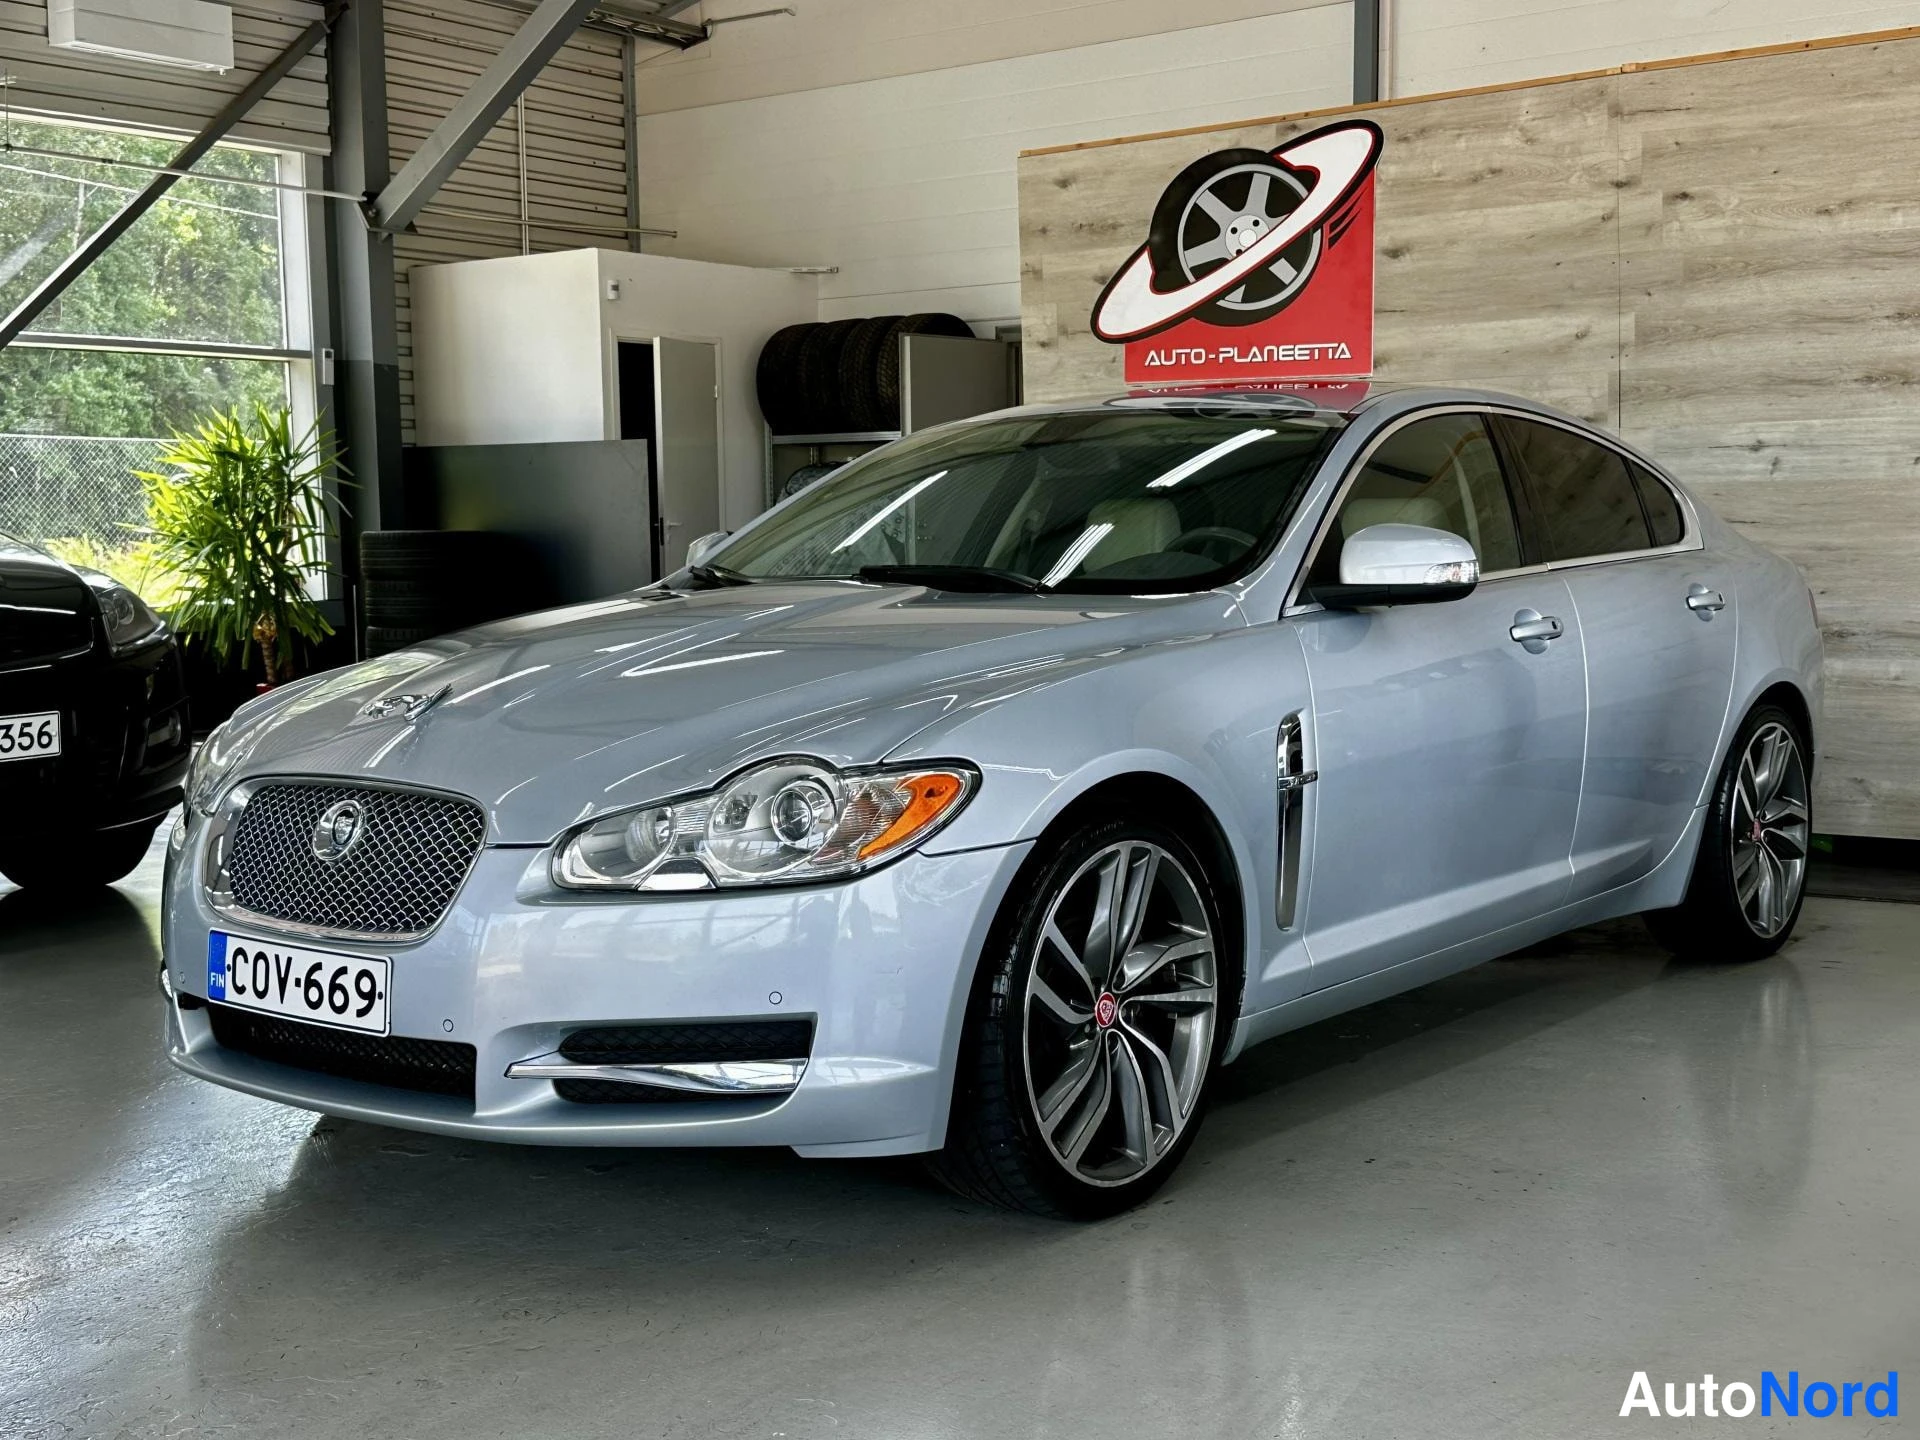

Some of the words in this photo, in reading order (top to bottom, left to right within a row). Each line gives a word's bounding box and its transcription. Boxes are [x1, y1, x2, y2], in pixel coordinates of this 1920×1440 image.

[1144, 342, 1352, 367] AUTO-PLANEETTA
[210, 971, 225, 988] FIN
[231, 946, 377, 1018] COV-669
